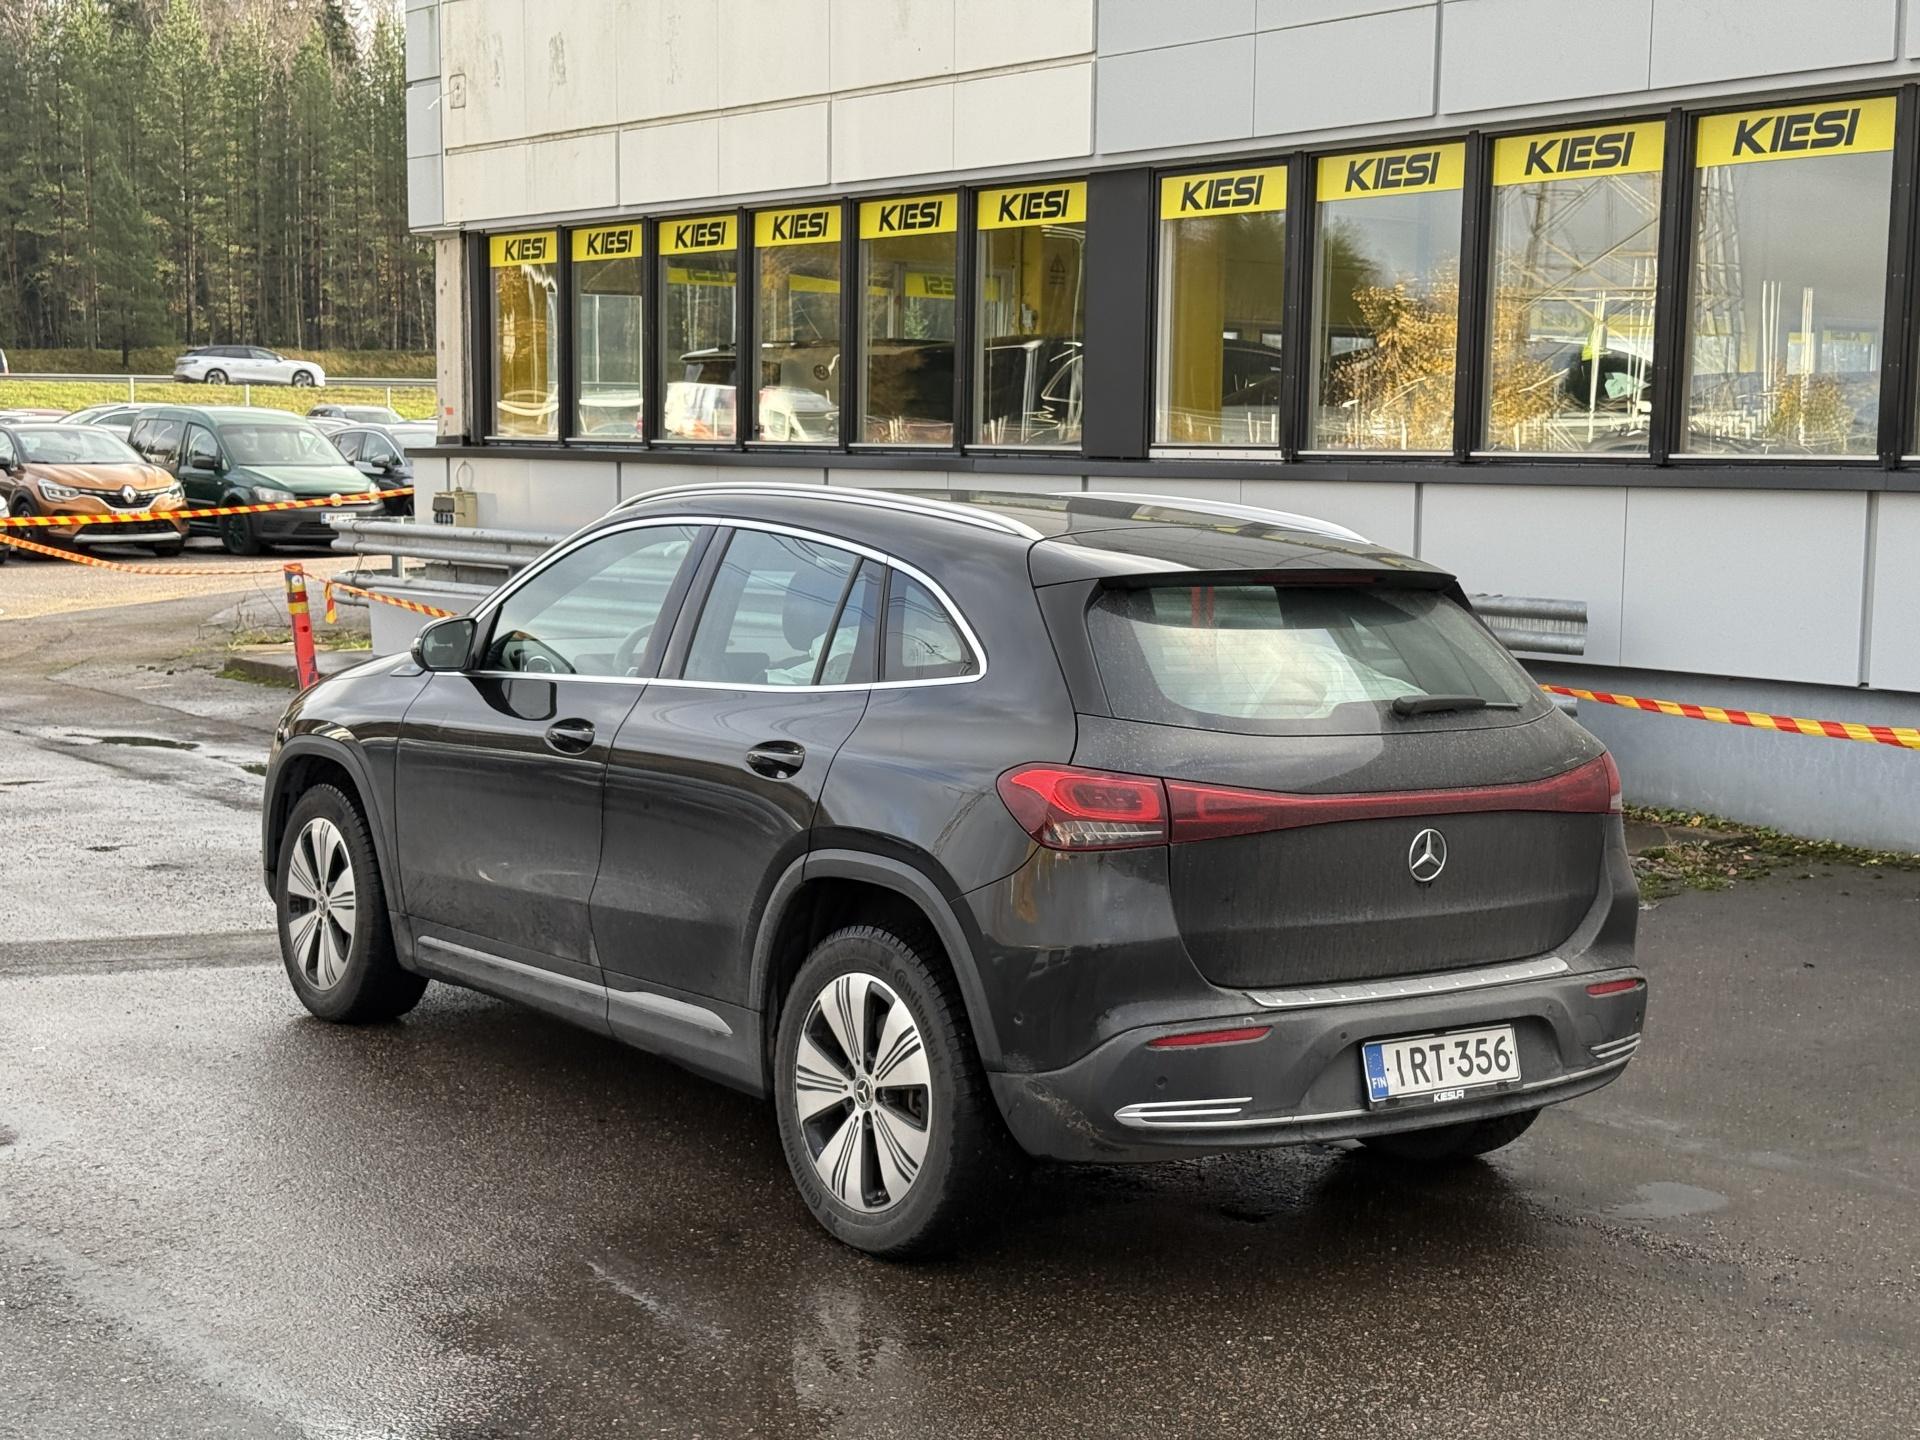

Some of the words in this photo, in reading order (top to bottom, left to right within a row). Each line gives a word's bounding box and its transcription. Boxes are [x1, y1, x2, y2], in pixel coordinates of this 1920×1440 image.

[1733, 109, 1861, 156] KIESI
[1525, 132, 1635, 175] KIESI
[1344, 152, 1440, 192] KIESI
[998, 190, 1070, 221] KIESI
[1180, 175, 1264, 211] KIESI
[772, 212, 830, 240] KIESI
[878, 201, 943, 231] KIESI
[504, 237, 547, 261] KIESI
[586, 230, 633, 256] KIESI
[674, 222, 727, 249] KIESI
[1395, 1035, 1511, 1087] IRT-356
[1371, 1076, 1388, 1089] FIN
